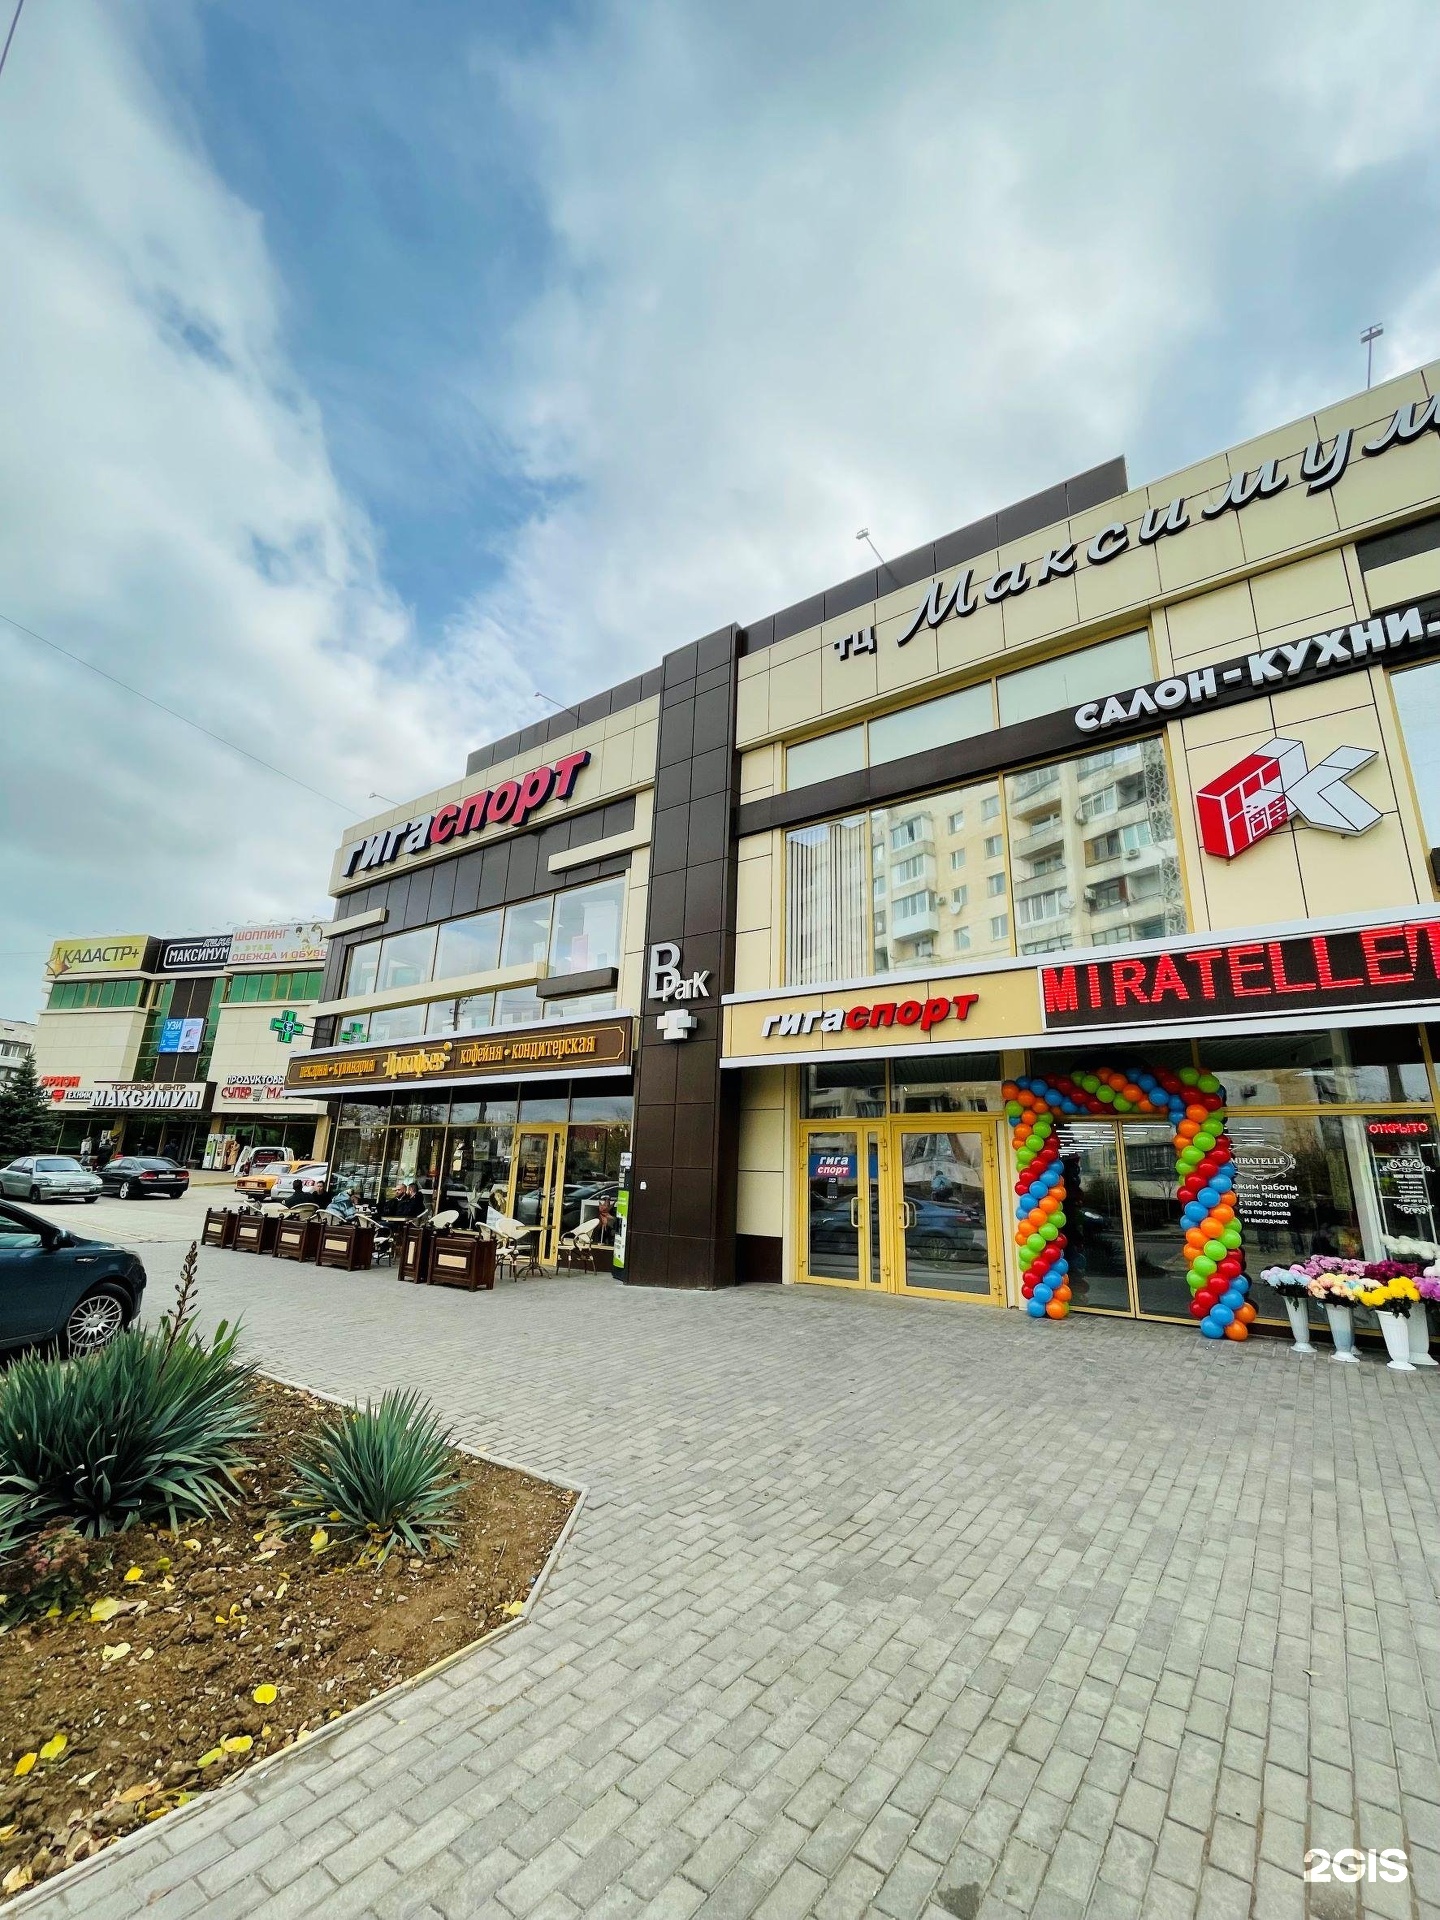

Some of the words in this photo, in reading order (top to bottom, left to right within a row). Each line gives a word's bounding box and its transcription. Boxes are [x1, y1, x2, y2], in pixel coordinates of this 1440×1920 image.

[235, 929, 289, 941] ШОППИНГ
[168, 946, 230, 963] МАКСИМУМ
[232, 952, 277, 962] ОДЕЖДА
[281, 951, 288, 959] И
[291, 949, 327, 959] ОБУВЬ
[460, 1042, 504, 1066] кофейня
[511, 1035, 597, 1059] кондитерская
[111, 1083, 155, 1091] ТОРГОВЫЙ
[158, 1083, 187, 1091] ЦЕНТР
[91, 1090, 201, 1107] МАКСИМУМ
[1369, 1123, 1428, 1134] ОТКРЫТО
[817, 1166, 849, 1176] спорт
[1261, 1183, 1298, 1191] работы
